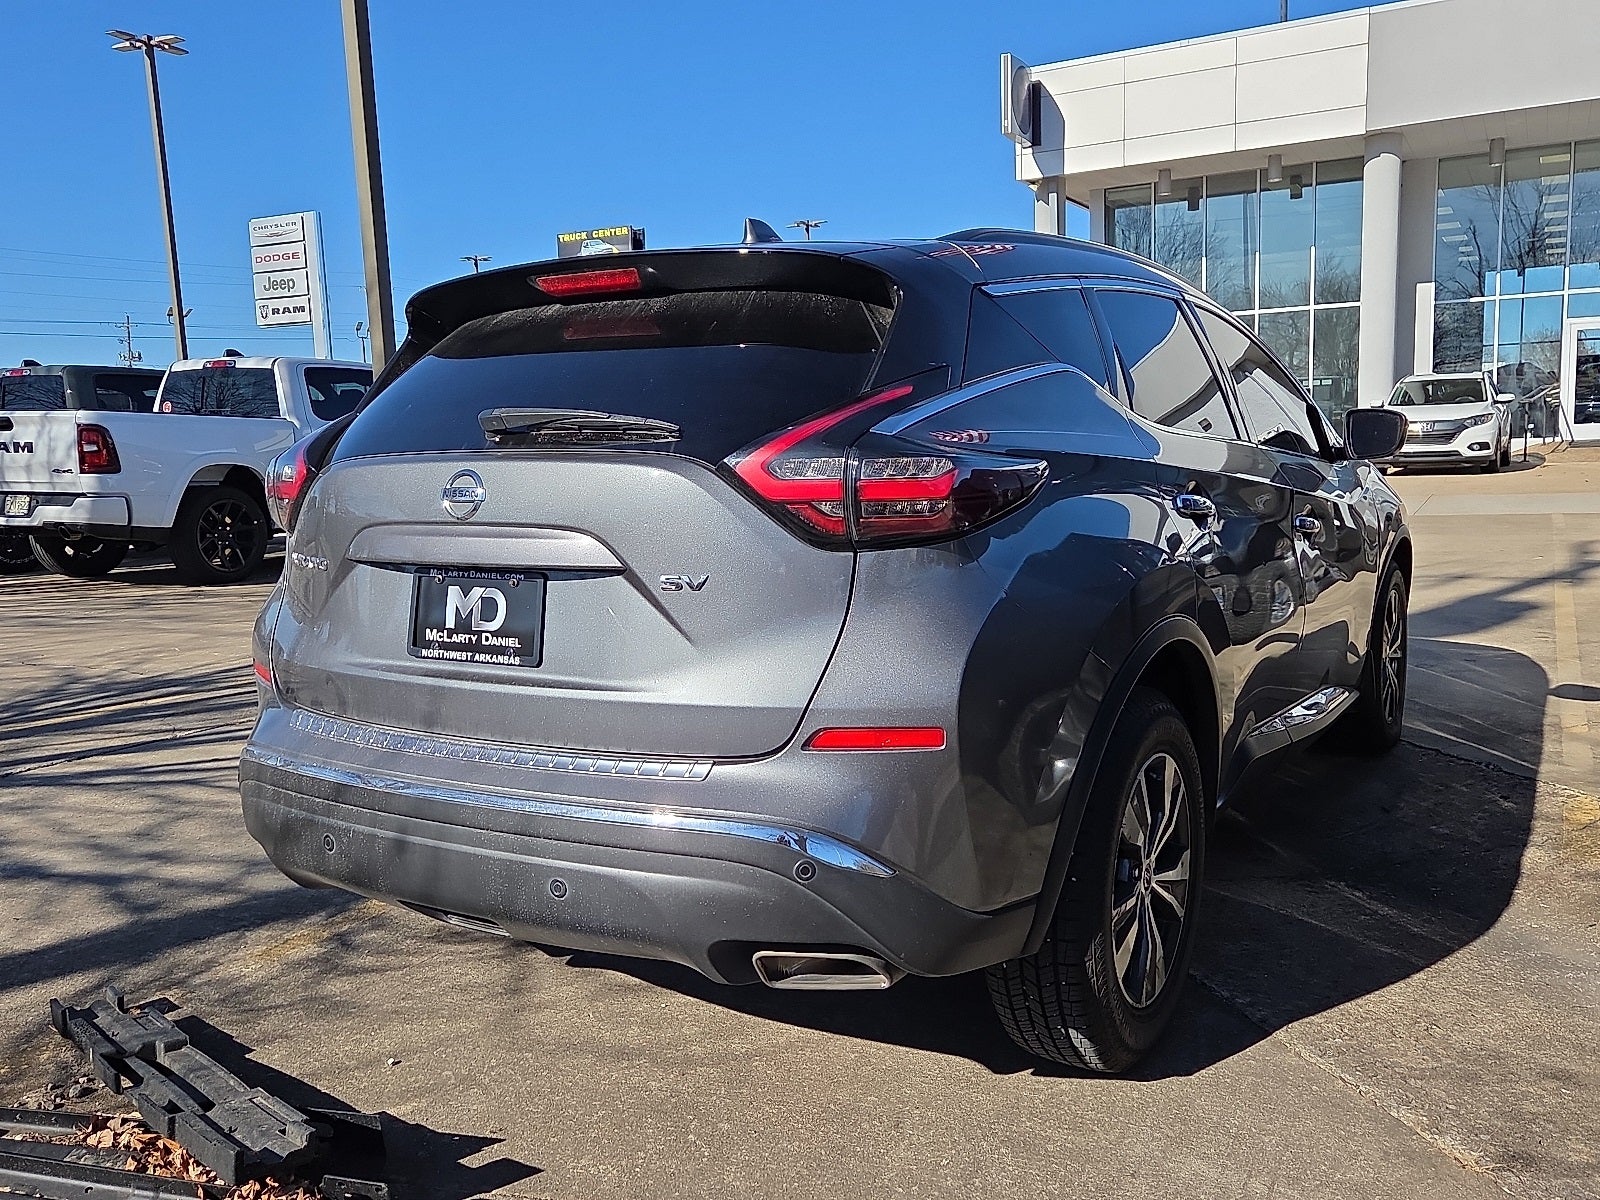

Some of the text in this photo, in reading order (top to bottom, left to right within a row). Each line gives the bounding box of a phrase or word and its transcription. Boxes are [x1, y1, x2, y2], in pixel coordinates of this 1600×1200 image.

[253, 221, 297, 231] CHRYSLER
[558, 227, 628, 242] TRUCK CENTER
[255, 252, 300, 264] DODGE
[263, 276, 296, 292] Jeep
[271, 305, 306, 316] RAM
[442, 489, 479, 499] NISSAN
[660, 574, 710, 592] SV
[445, 585, 507, 632] MD
[481, 632, 522, 648] DANIEL
[421, 648, 520, 665] NORTHWEST ARKANSAS
